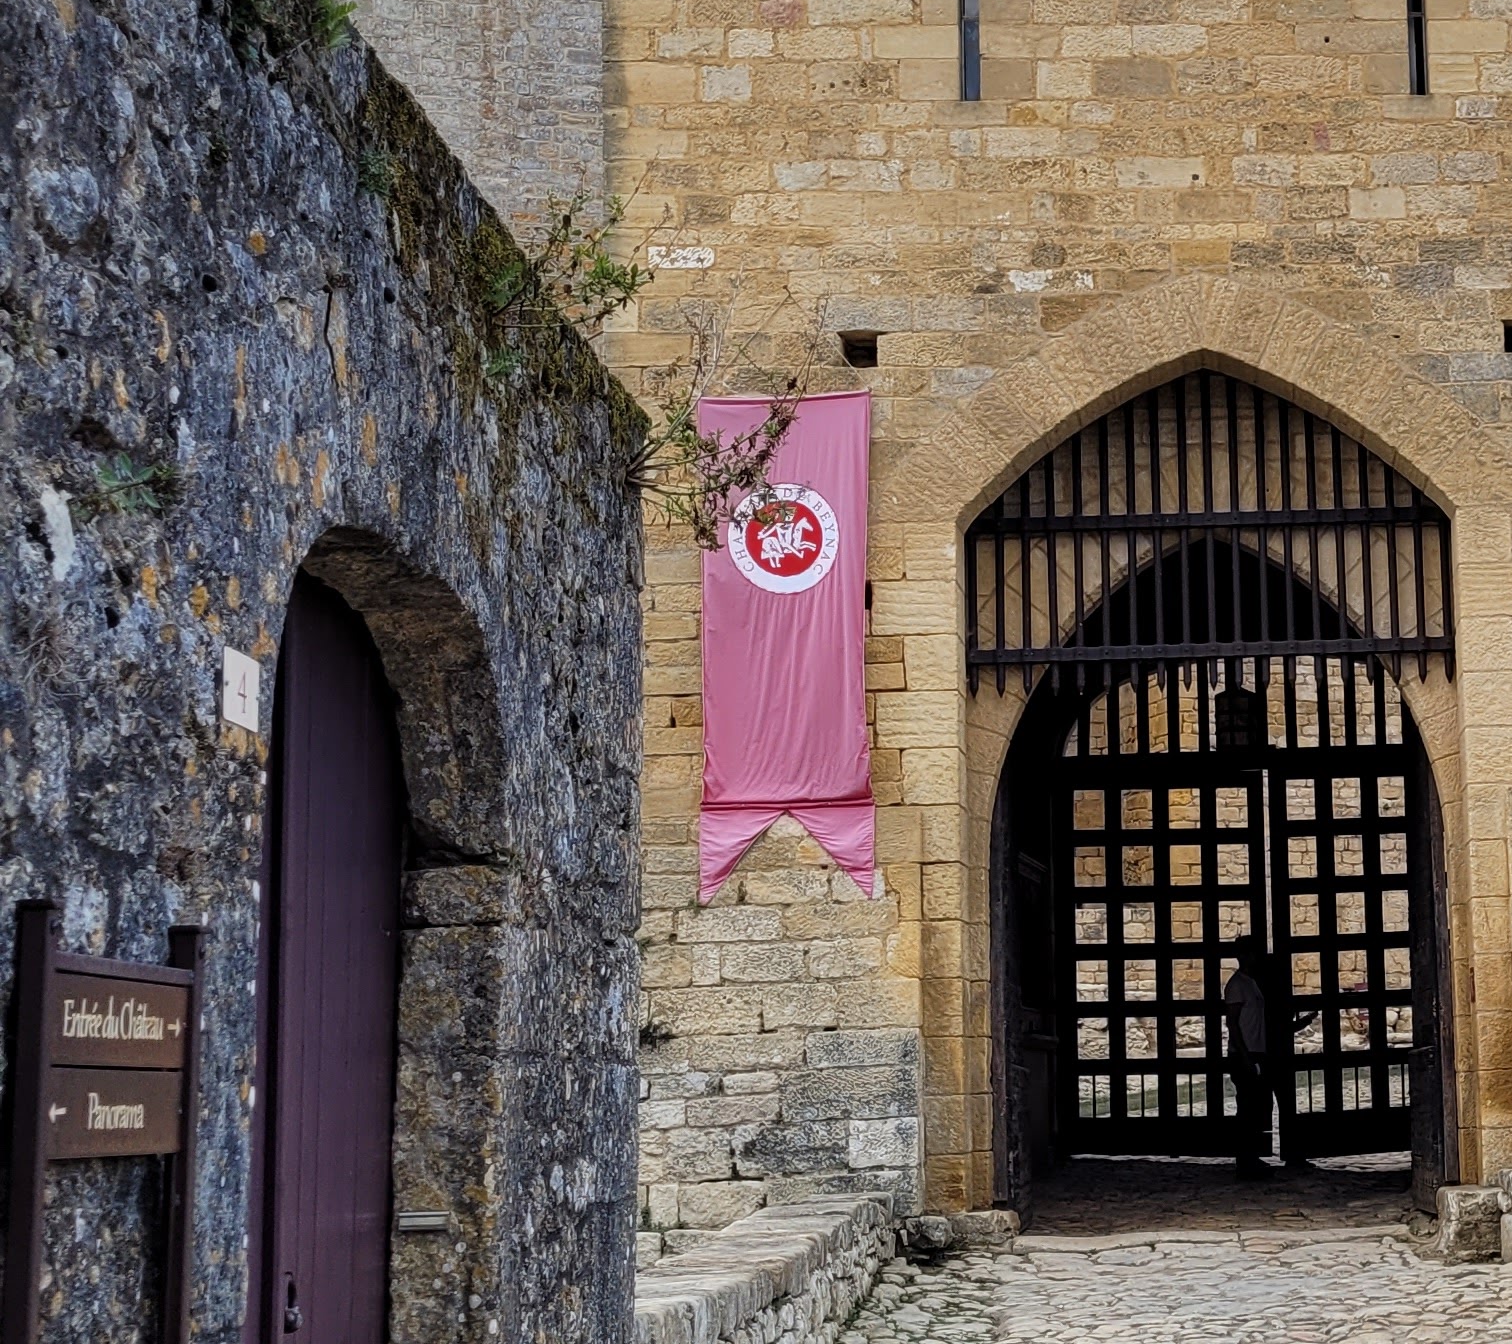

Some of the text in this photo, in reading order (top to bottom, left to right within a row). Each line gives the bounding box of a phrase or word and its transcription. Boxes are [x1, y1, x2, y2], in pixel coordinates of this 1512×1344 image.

[812, 501, 836, 575] BEYNAC
[237, 671, 248, 714] 4
[62, 995, 165, 1041] Entrée du Château
[87, 1092, 145, 1131] Panorama
